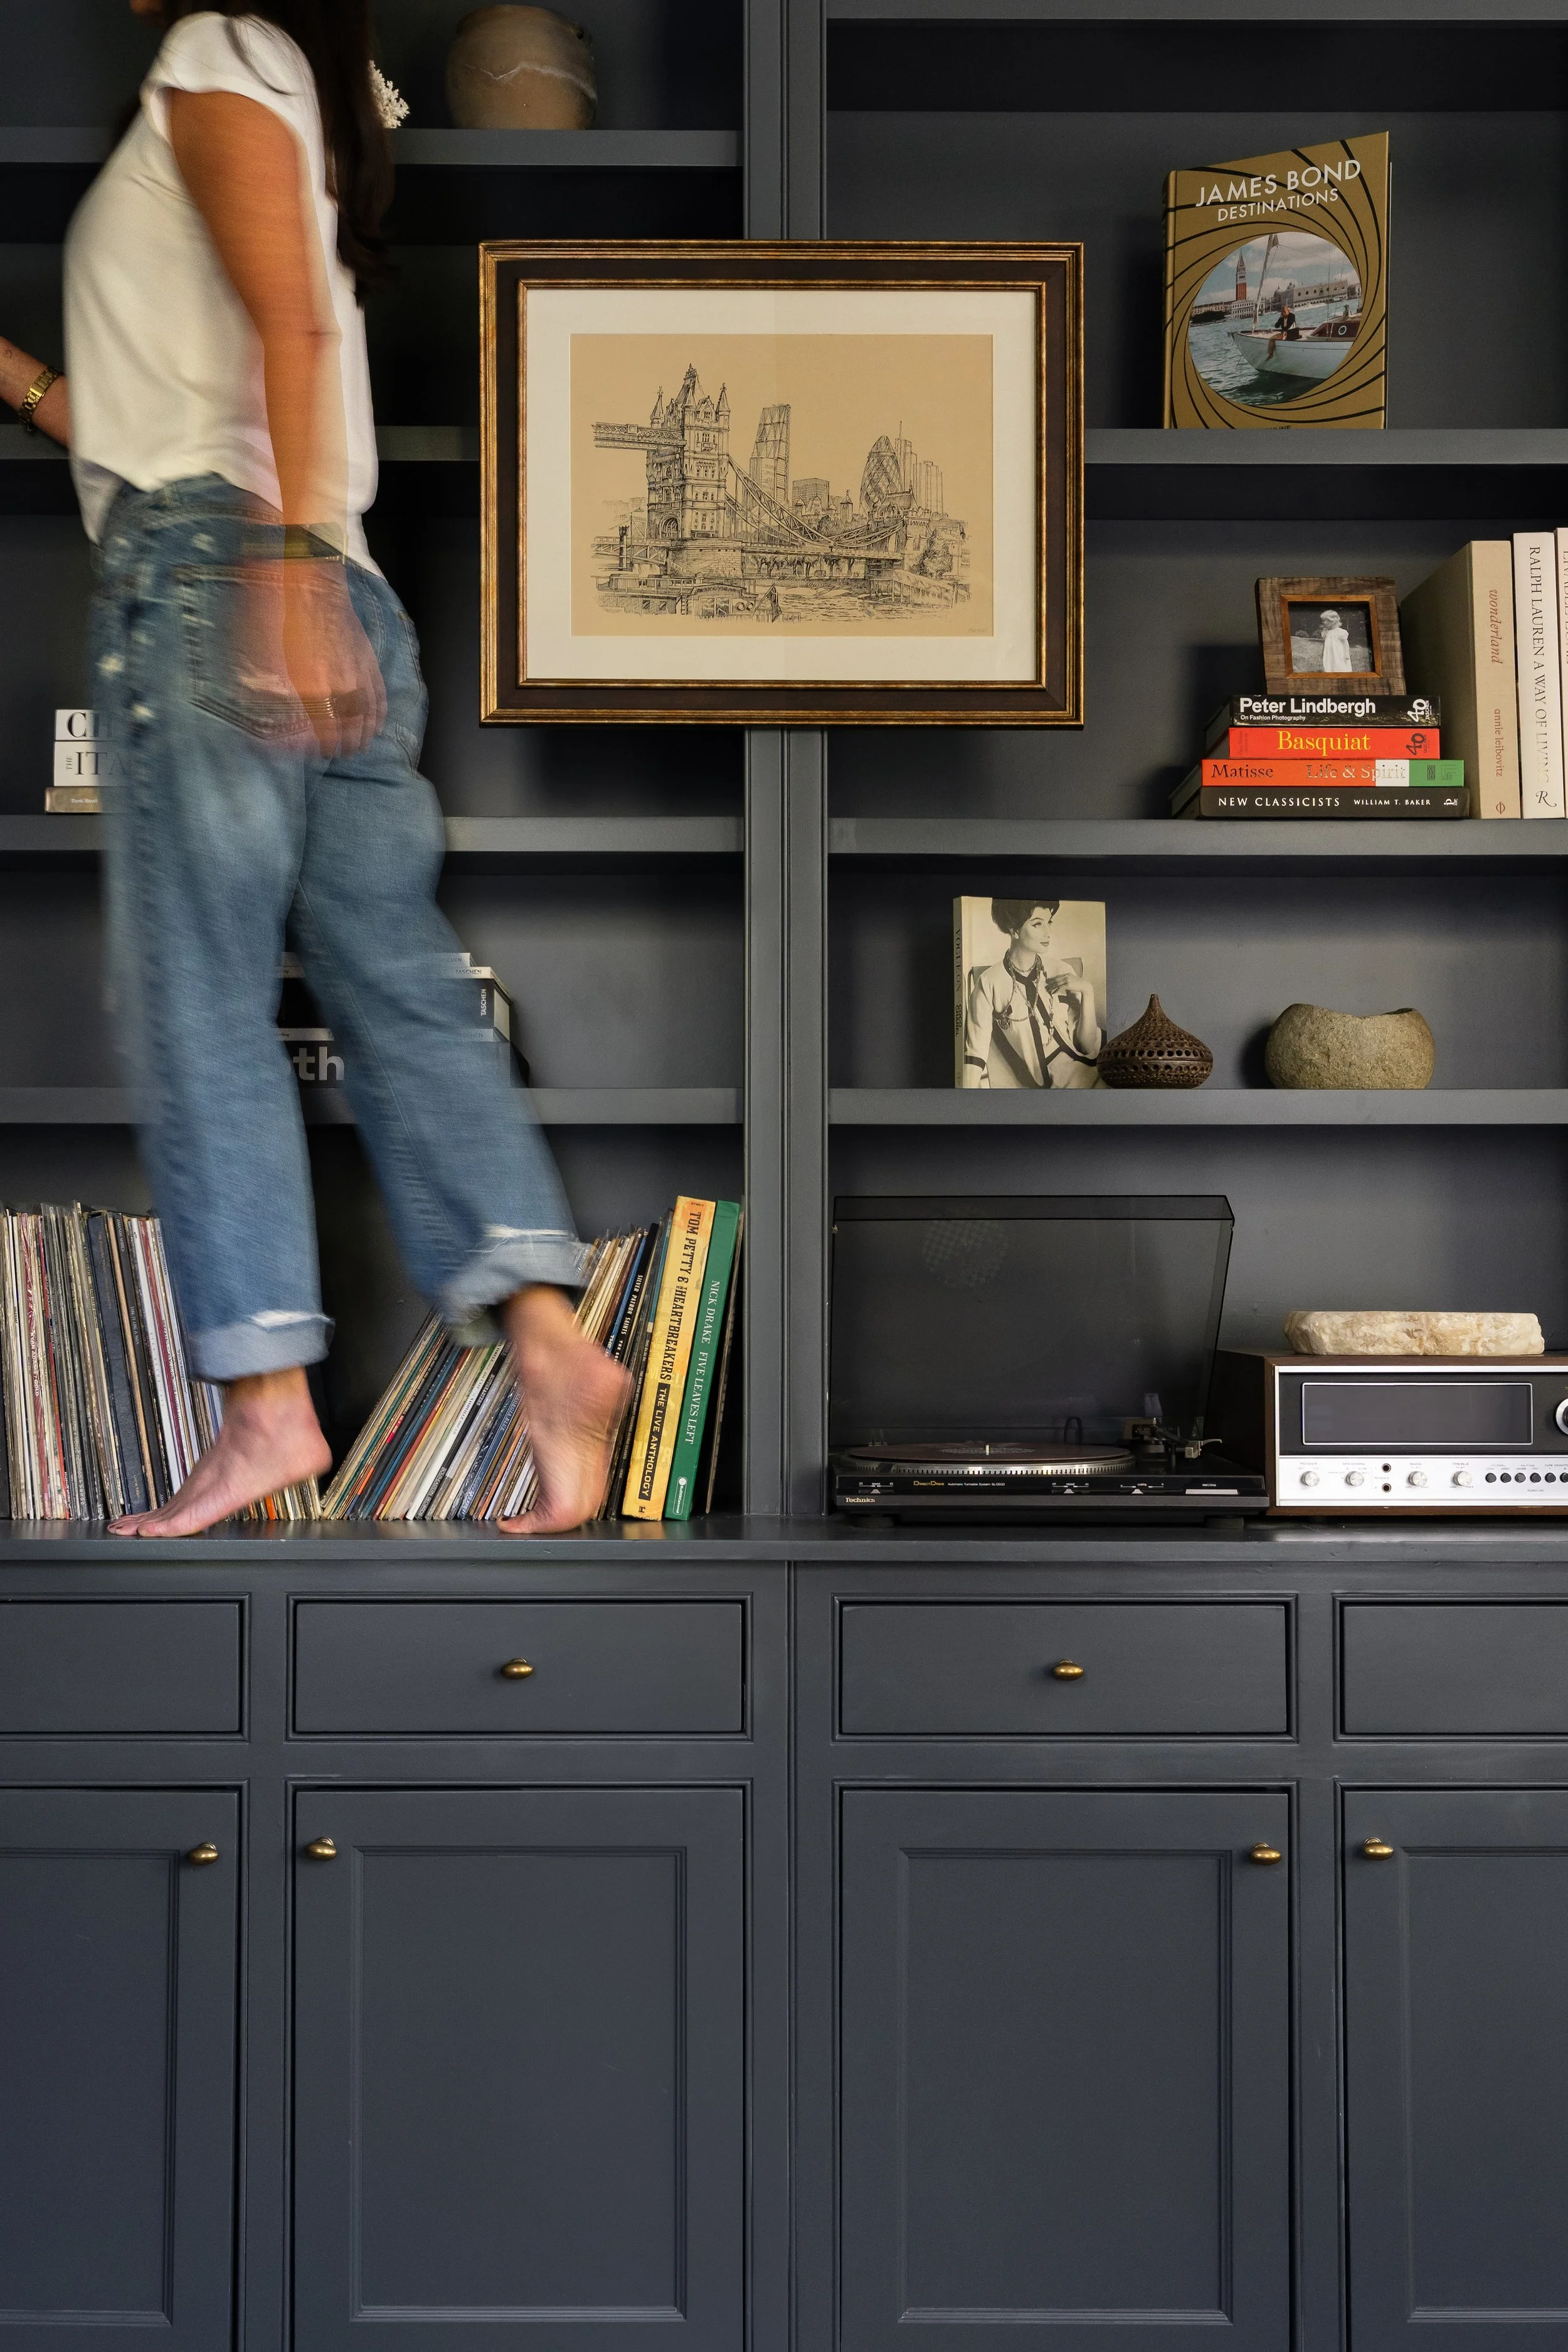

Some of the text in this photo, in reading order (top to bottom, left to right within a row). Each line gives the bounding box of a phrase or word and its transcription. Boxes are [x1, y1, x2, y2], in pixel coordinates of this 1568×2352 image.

[1195, 159, 1360, 207] JAMES BOND
[1218, 188, 1338, 221] DESTINATIONS
[1488, 589, 1503, 664] wonderland
[1529, 546, 1549, 783] RALPH LAUREN A WAY OF LIVING
[1240, 697, 1376, 718] Peter Lindbergh
[1407, 699, 1427, 722] 40
[1277, 731, 1371, 756] Basquiat
[1406, 733, 1426, 755] 40
[1494, 709, 1503, 776] annie leibovitz
[1211, 764, 1406, 781] Matisse Life & Spirit
[1218, 797, 1248, 807] NEW
[1255, 797, 1340, 807] CLASSICISTS
[1535, 790, 1557, 807] R
[686, 1210, 702, 1235] TOM
[678, 1237, 697, 1274] PETTY
[620, 1274, 643, 1335] SILVER PATRON SAINTS
[606, 1333, 615, 1349] THE
[659, 1288, 687, 1381] HEARTBREAKERS
[684, 1279, 721, 1445] NICK DRAKE FIVE LEAVES LEFT
[475, 1373, 495, 1406] SOUTHEASTERN
[500, 1392, 521, 1432] GEORGIA BLUE
[640, 1387, 667, 1496] THE LIVE ANTHOLOGY
[418, 1466, 447, 1517] SOUTHEASTERN RECORDS
